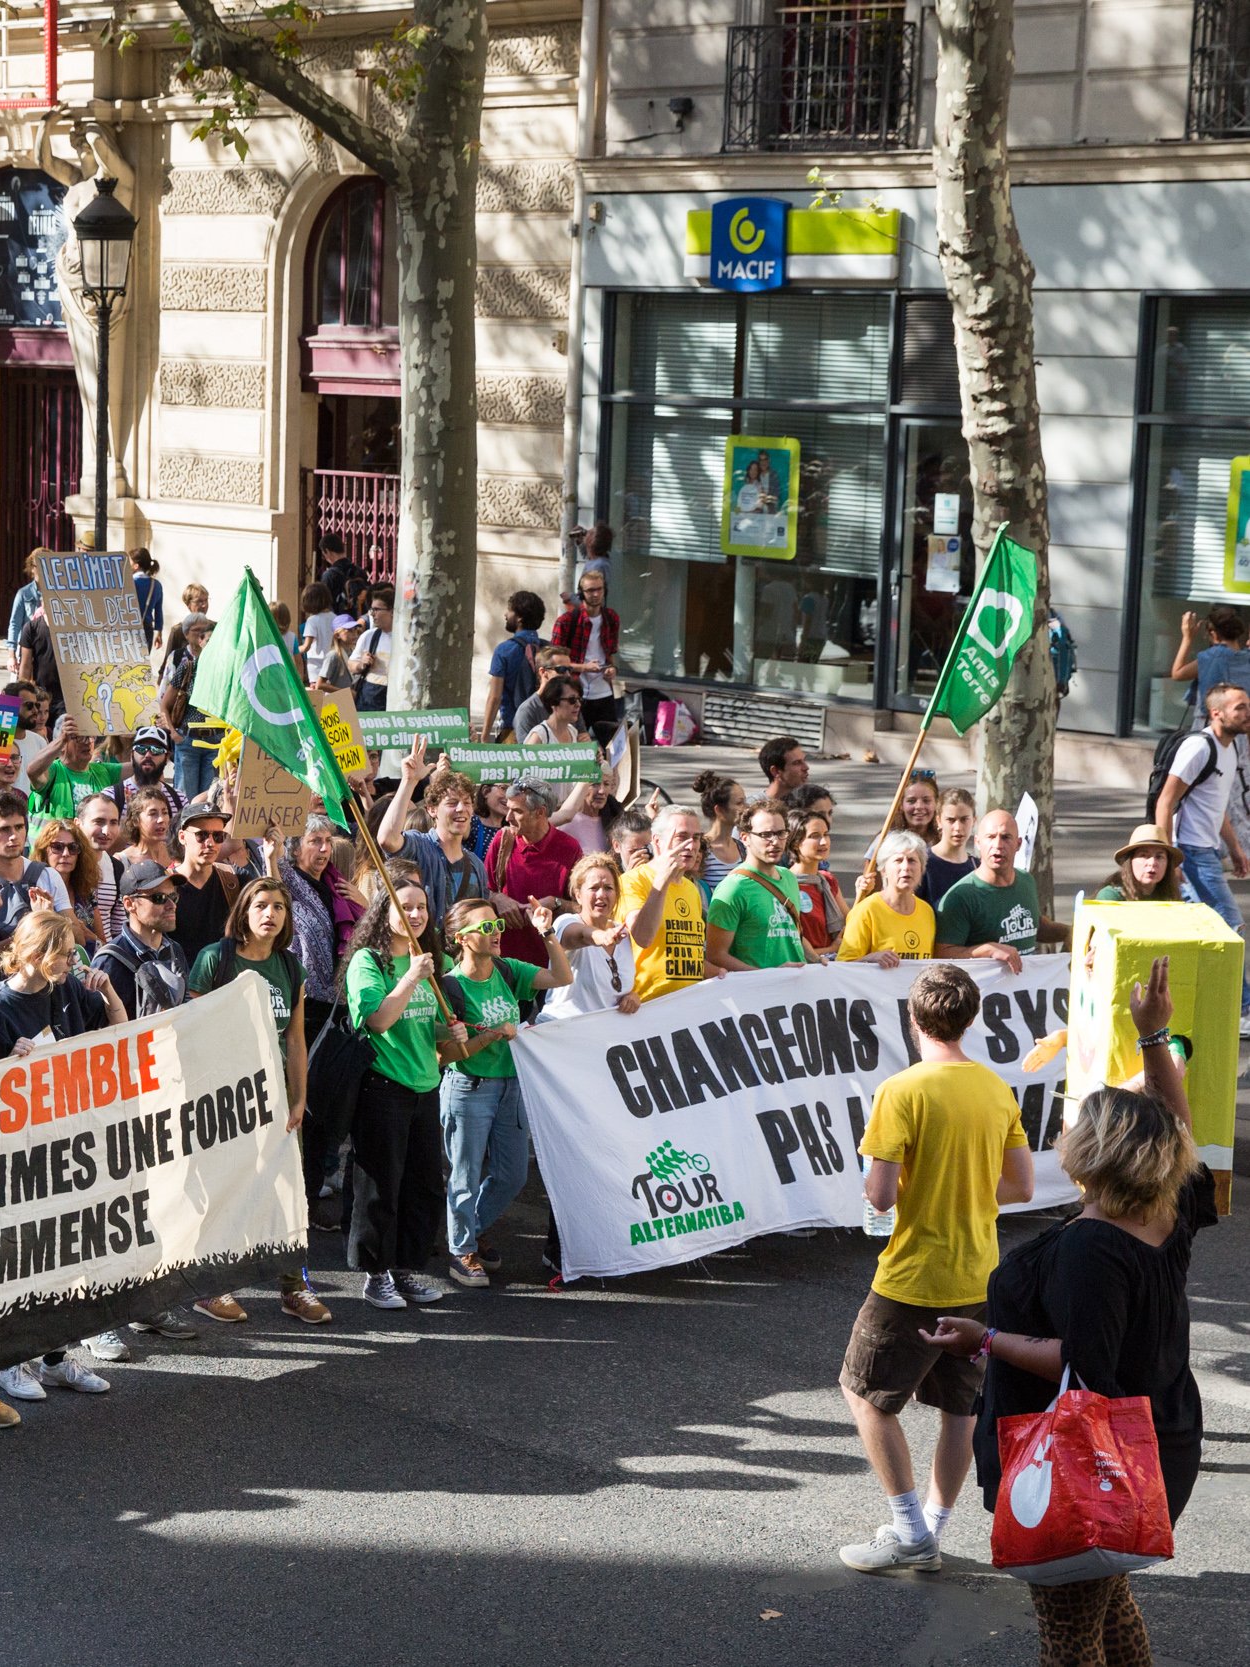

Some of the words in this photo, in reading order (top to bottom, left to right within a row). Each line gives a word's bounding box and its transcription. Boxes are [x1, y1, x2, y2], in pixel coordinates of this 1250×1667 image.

[717, 260, 776, 280] MACIF
[105, 594, 141, 627] DES
[961, 646, 999, 688] Amis
[956, 657, 991, 705] Terre
[391, 715, 406, 728] le
[376, 732, 389, 746] le
[449, 746, 521, 763] Changeons
[522, 748, 537, 761] le
[480, 767, 505, 782] pas
[243, 786, 257, 799] DE
[666, 919, 692, 932] DEBOUT
[666, 946, 692, 958] POUR
[605, 996, 879, 1119] CHANGEONS
[105, 1107, 175, 1181] UNE
[179, 1067, 274, 1158] FORCE
[755, 1100, 845, 1186] PAS
[631, 1171, 724, 1221] TOUR
[629, 1200, 746, 1246] ALTERNATIBA
